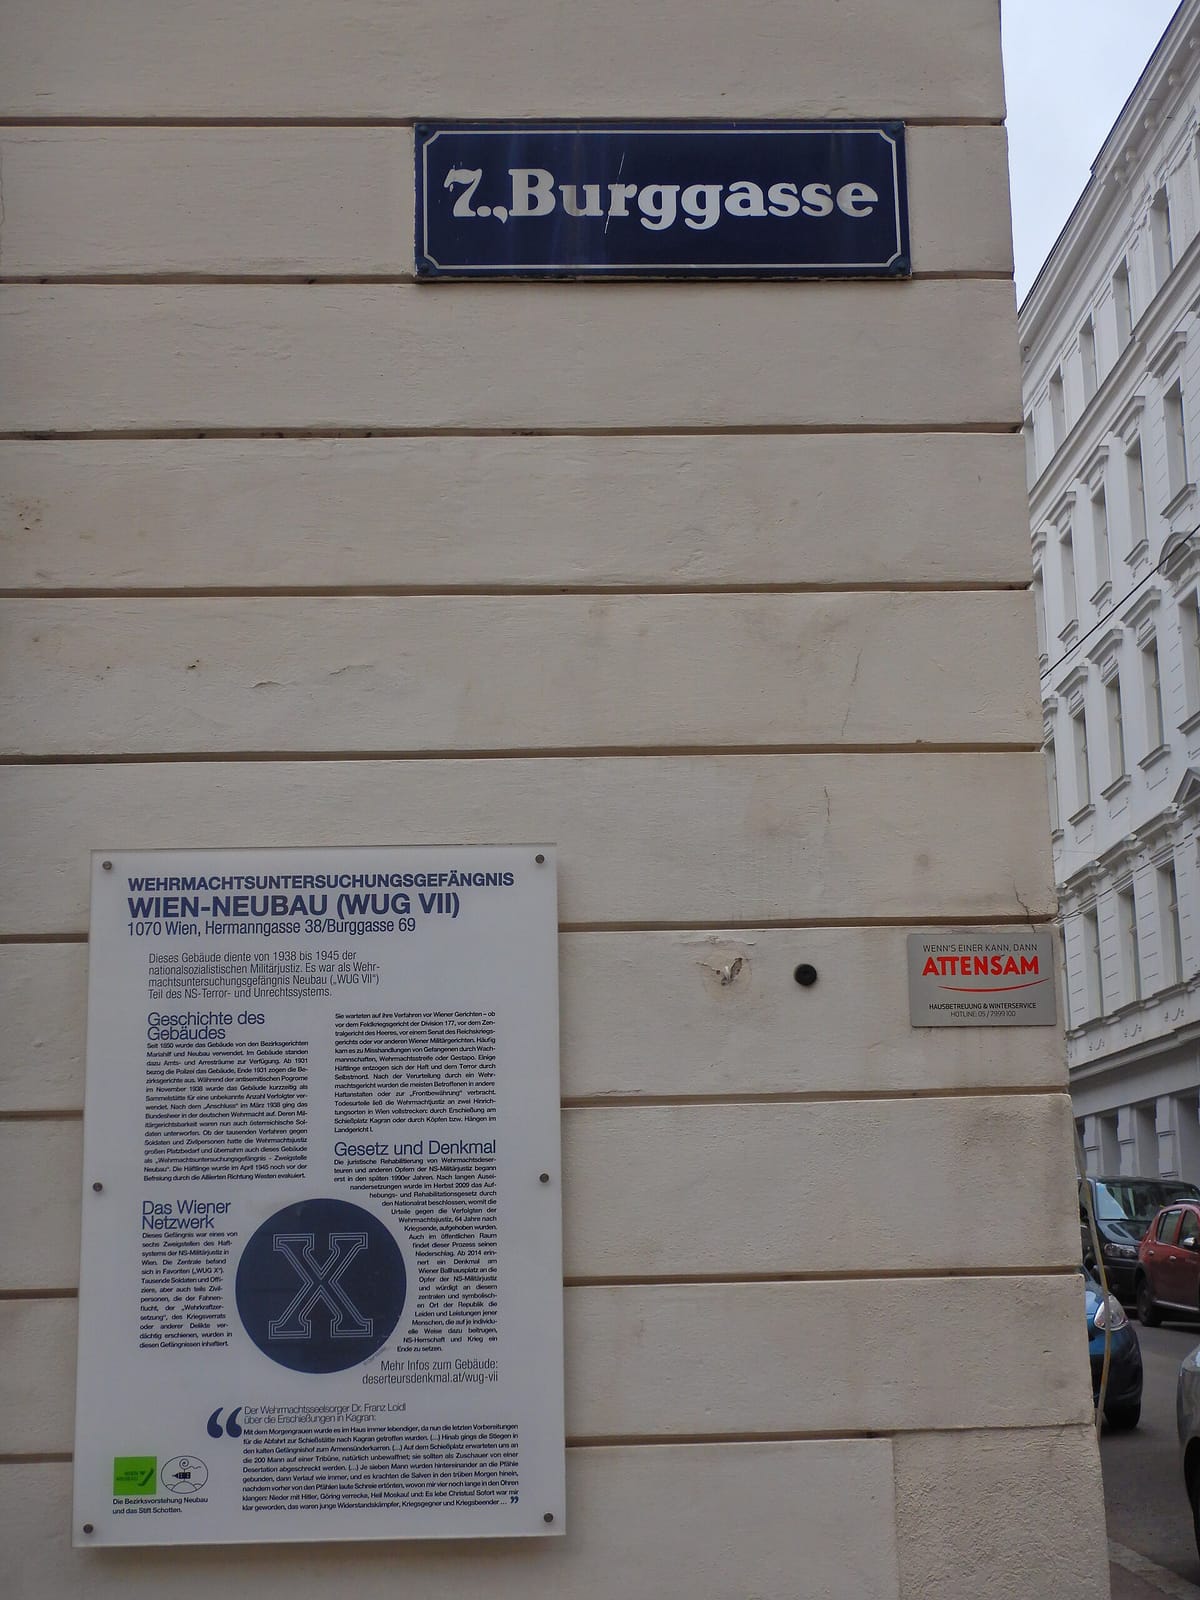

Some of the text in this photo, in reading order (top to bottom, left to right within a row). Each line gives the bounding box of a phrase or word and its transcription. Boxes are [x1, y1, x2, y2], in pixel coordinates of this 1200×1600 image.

[128, 872, 514, 892] WEHRMACHTSUNTERSUCHUNGSGEFÄNGNIS
[128, 892, 460, 919] WIEN-NEUBAU (WUG VII)
[128, 917, 416, 937] 1070 Wien, Hermanngasse 38/Burggasse 69
[958, 944, 983, 952] EINER
[149, 950, 356, 966] Dieses Gebäude diente von 1938 bis 1945 der
[148, 963, 248, 976] nationalsozialistischen
[305, 962, 316, 974] Es
[319, 964, 335, 977] war
[338, 962, 351, 977] als
[353, 962, 380, 976] Wehr-
[922, 955, 1040, 977] ATTENSAM
[148, 974, 290, 987] machtsuntersuchungsgefängnis
[293, 975, 327, 989] Neubau
[148, 989, 163, 999] Teil
[166, 989, 182, 999] des
[185, 988, 231, 998] NS-Terror-
[234, 987, 251, 998] und
[148, 1011, 265, 1026] Geschichte des
[147, 1026, 226, 1040] Gebäudes
[334, 1140, 496, 1156] Gesetz und Denkmal
[143, 1200, 232, 1215] Das Wiener
[142, 1215, 214, 1230] Netzwerk
[268, 1232, 374, 1340] X
[381, 1358, 498, 1370] Mehr Infos zum Gebäude:
[362, 1372, 498, 1384] deserteursdenkmal.at/wug-vii
[244, 1406, 258, 1414] Der
[364, 1403, 386, 1412] Franz
[388, 1402, 406, 1412] Loidl
[244, 1416, 262, 1424] über
[264, 1414, 276, 1423] die
[278, 1414, 336, 1424] Erschießungen
[337, 1414, 344, 1422] in
